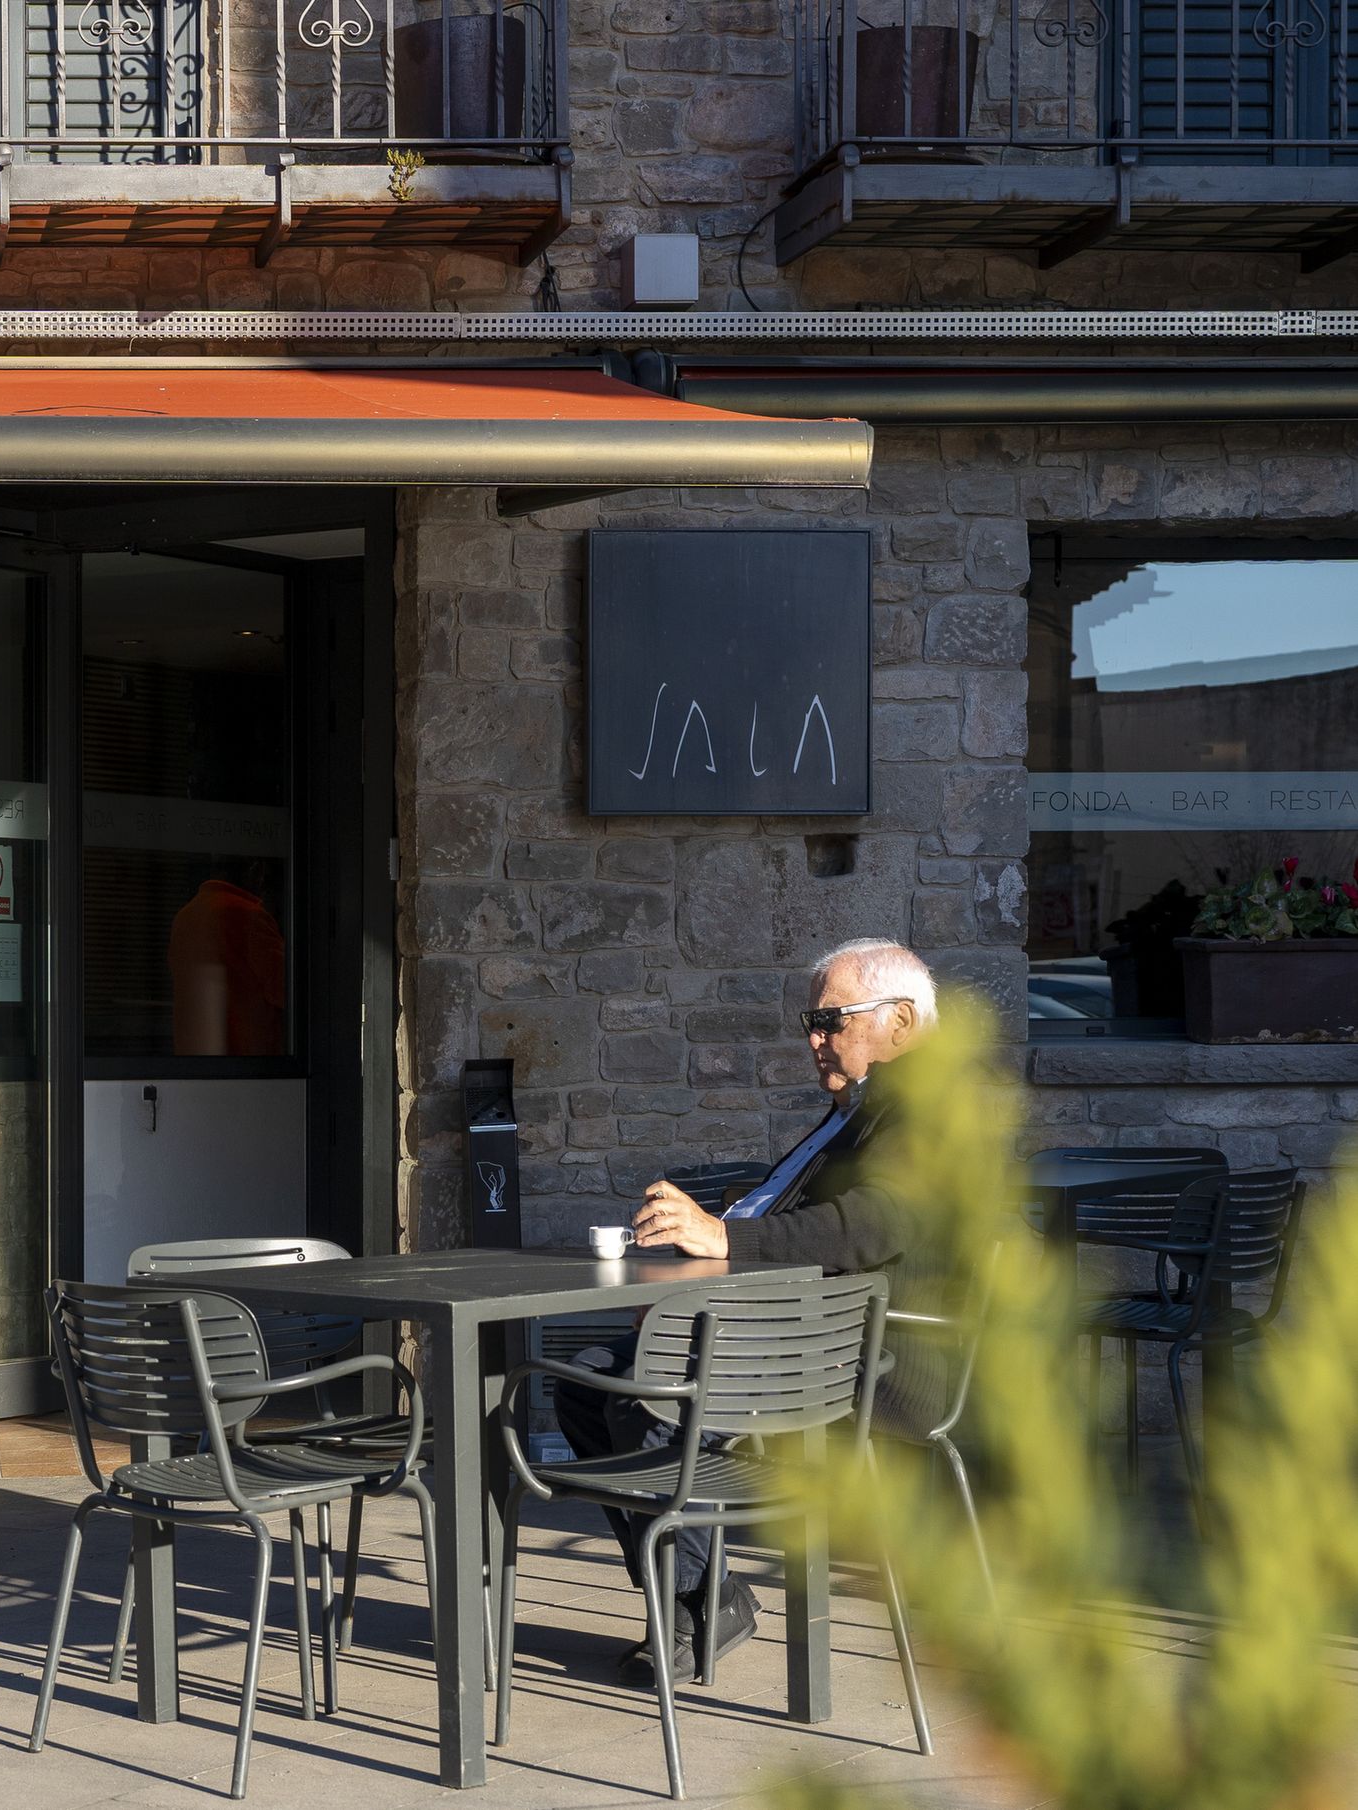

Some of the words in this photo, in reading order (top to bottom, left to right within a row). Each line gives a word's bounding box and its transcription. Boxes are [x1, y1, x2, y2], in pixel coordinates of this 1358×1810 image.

[1031, 790, 1131, 812] FONDA
[1171, 790, 1230, 811] BAR
[1269, 790, 1358, 811] RESTA
